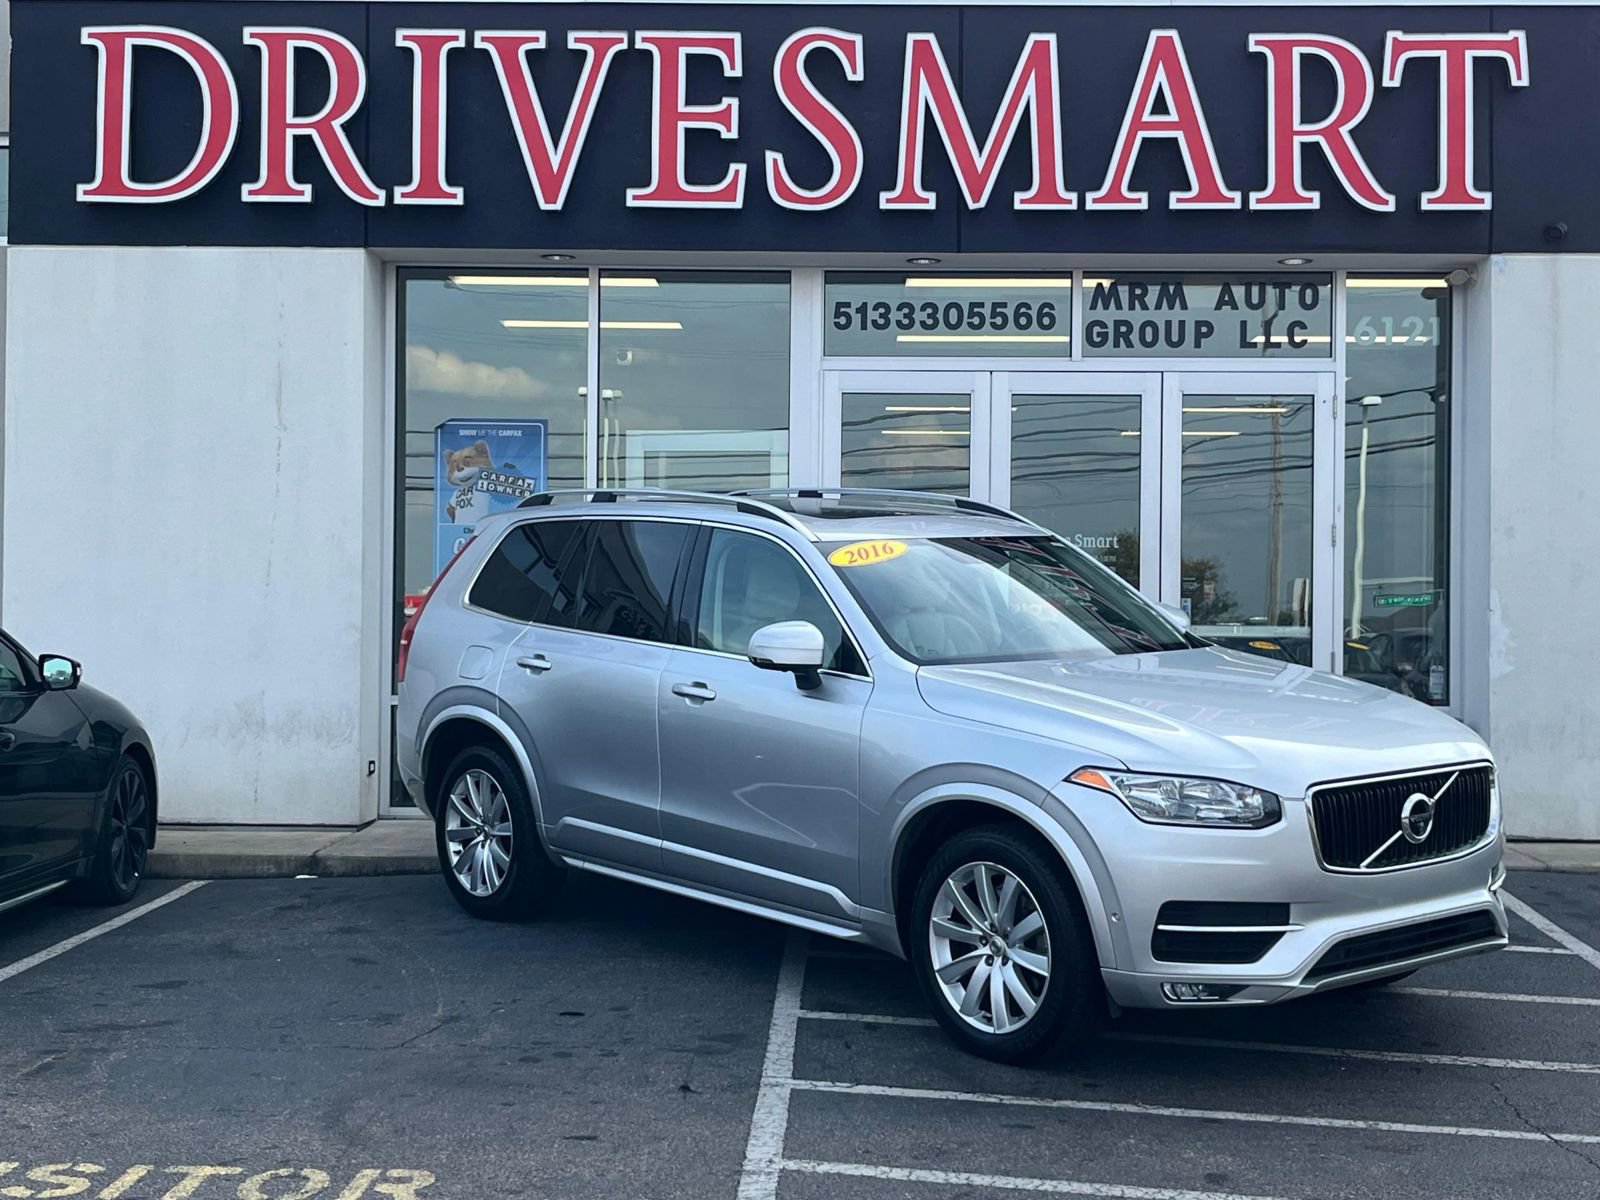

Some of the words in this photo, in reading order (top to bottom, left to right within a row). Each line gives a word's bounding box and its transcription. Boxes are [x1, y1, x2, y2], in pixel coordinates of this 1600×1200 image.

[76, 25, 1531, 213] DRIVESMART
[1089, 281, 1189, 311] MRM
[1213, 281, 1321, 311] AUTO
[833, 301, 1057, 331] 5133305566
[1354, 315, 1440, 347] 6121
[1085, 319, 1215, 349] GROUP
[1239, 319, 1309, 349] LLC
[481, 471, 535, 489] CARFAX
[844, 542, 895, 564] 2016
[1074, 533, 1119, 549] Smart
[0, 1161, 436, 1199] SITOR
